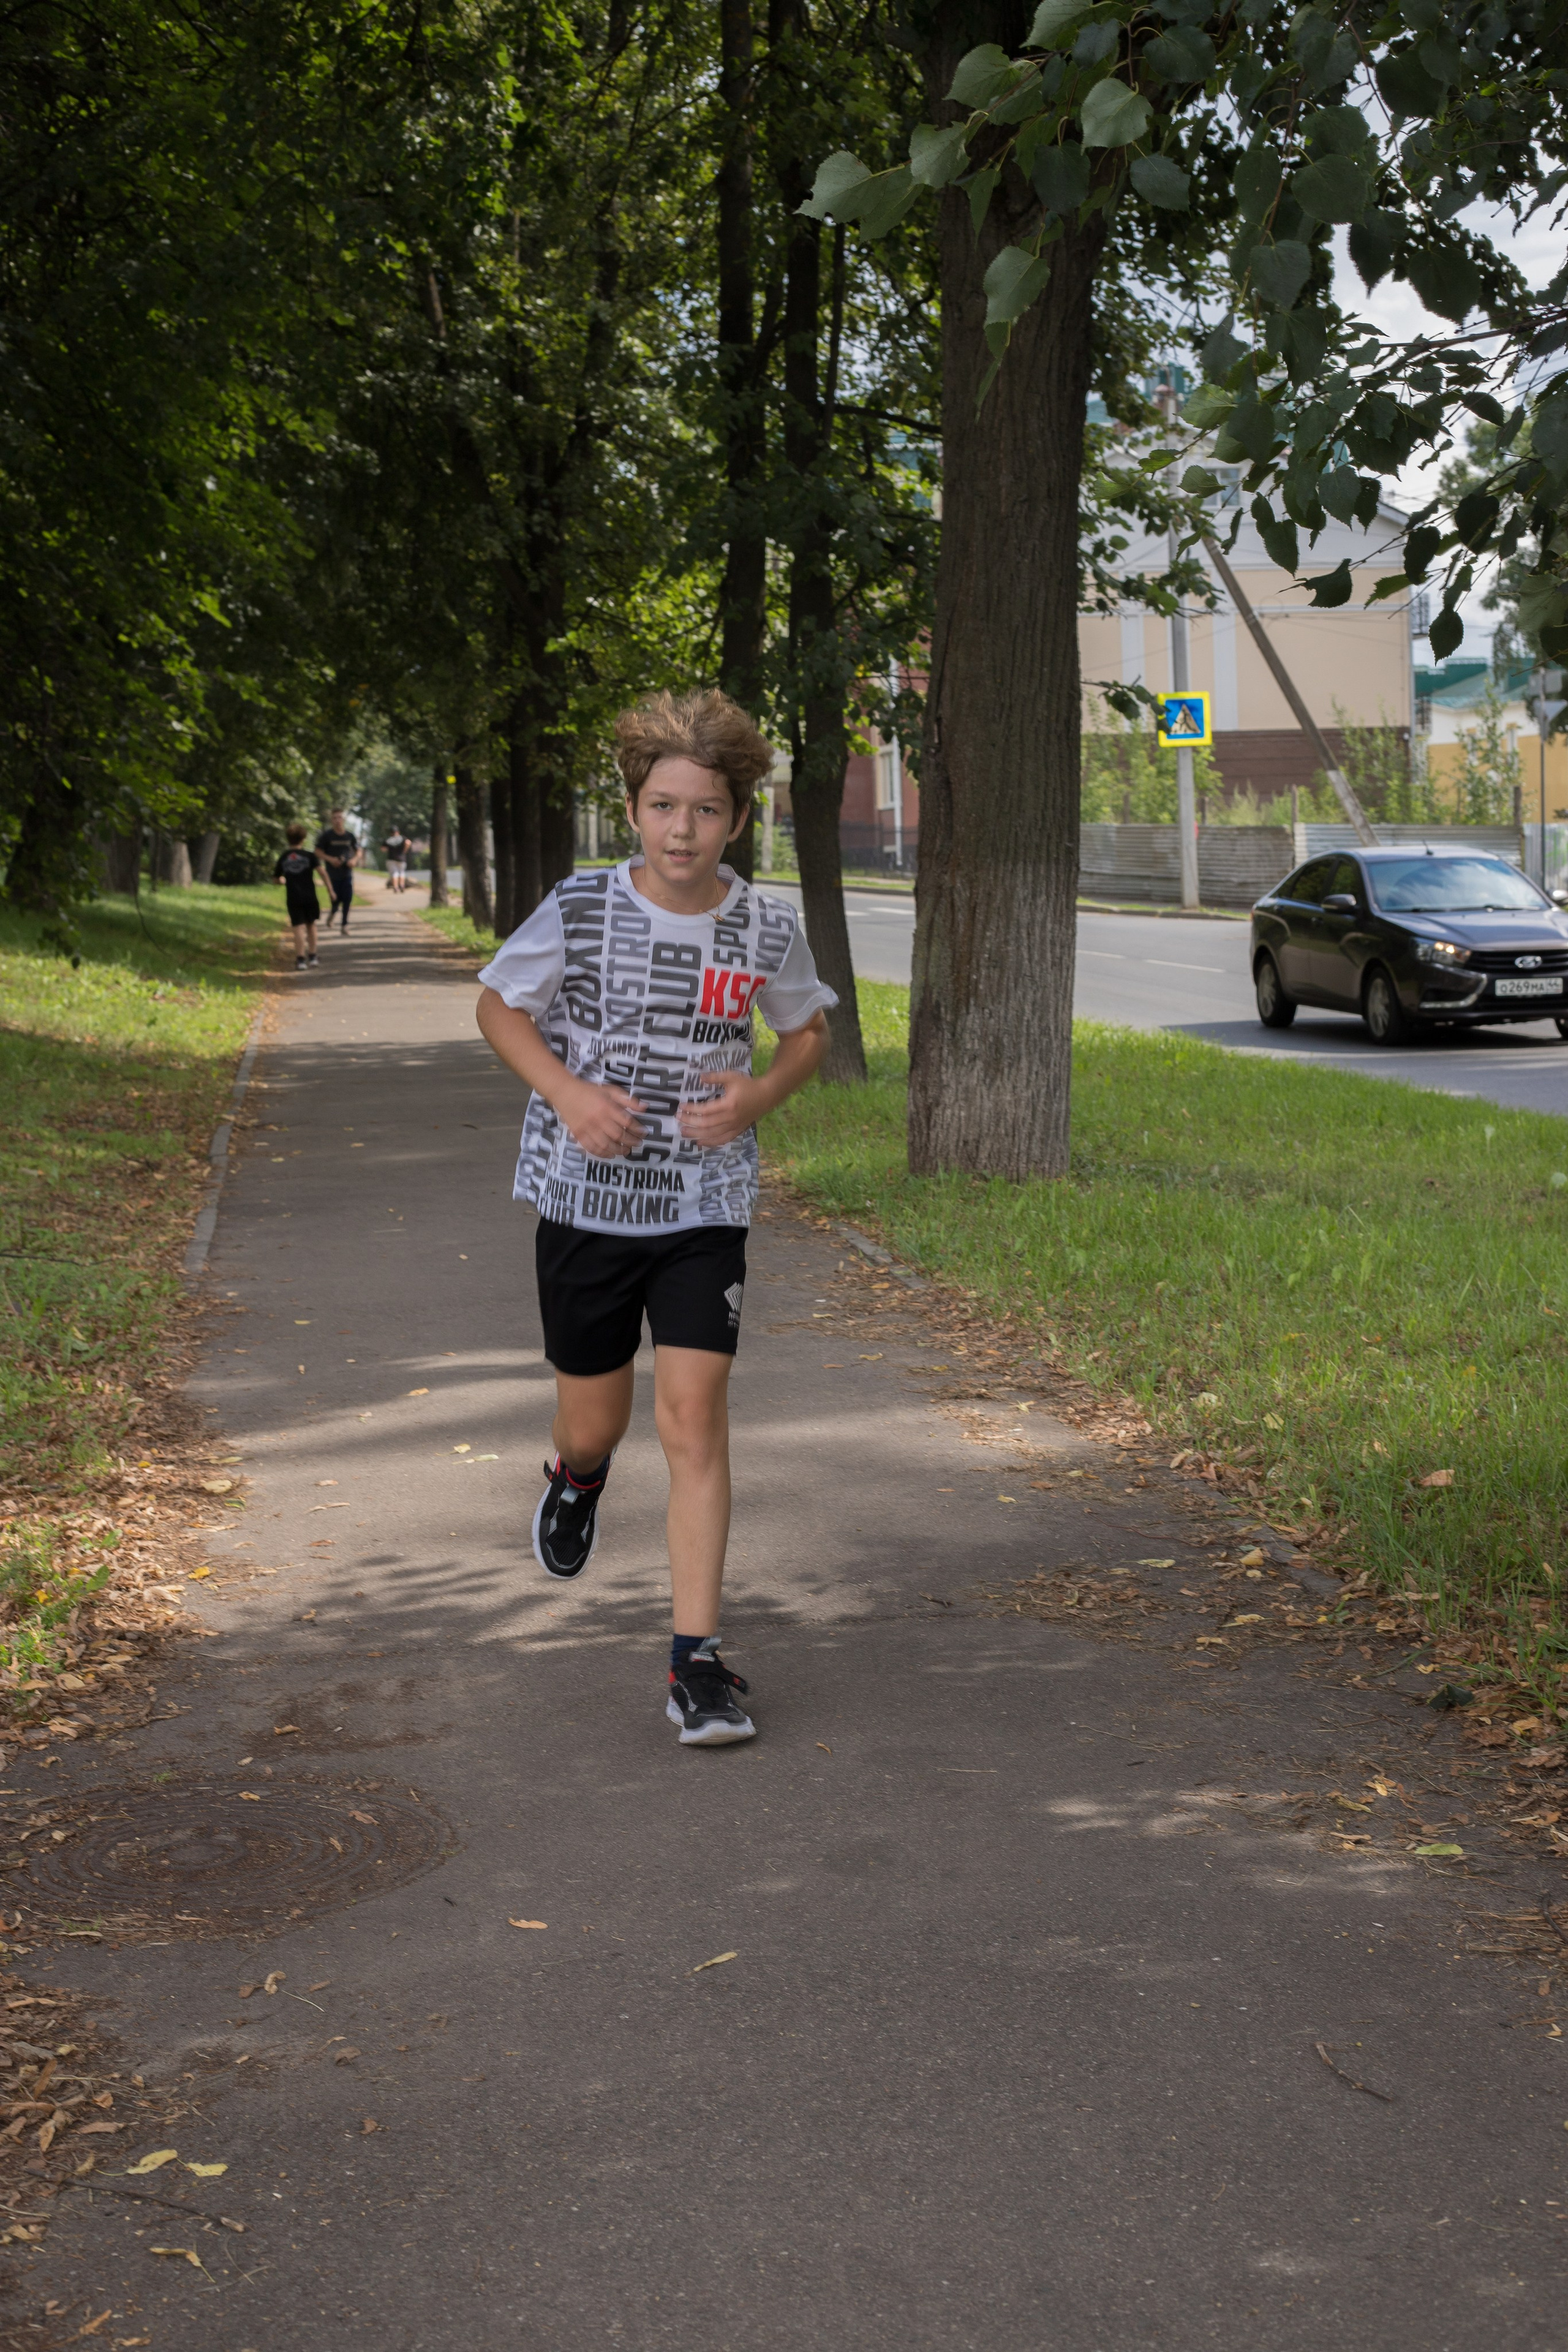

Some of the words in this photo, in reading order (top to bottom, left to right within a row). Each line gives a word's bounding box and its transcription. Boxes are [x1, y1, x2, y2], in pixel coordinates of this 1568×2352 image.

[556, 873, 608, 1034] BOXING
[643, 941, 702, 1039] CLUB
[624, 1043, 687, 1162] SPORT
[582, 1185, 679, 1224] BOXING
[586, 1159, 685, 1192] KOSTROMA
